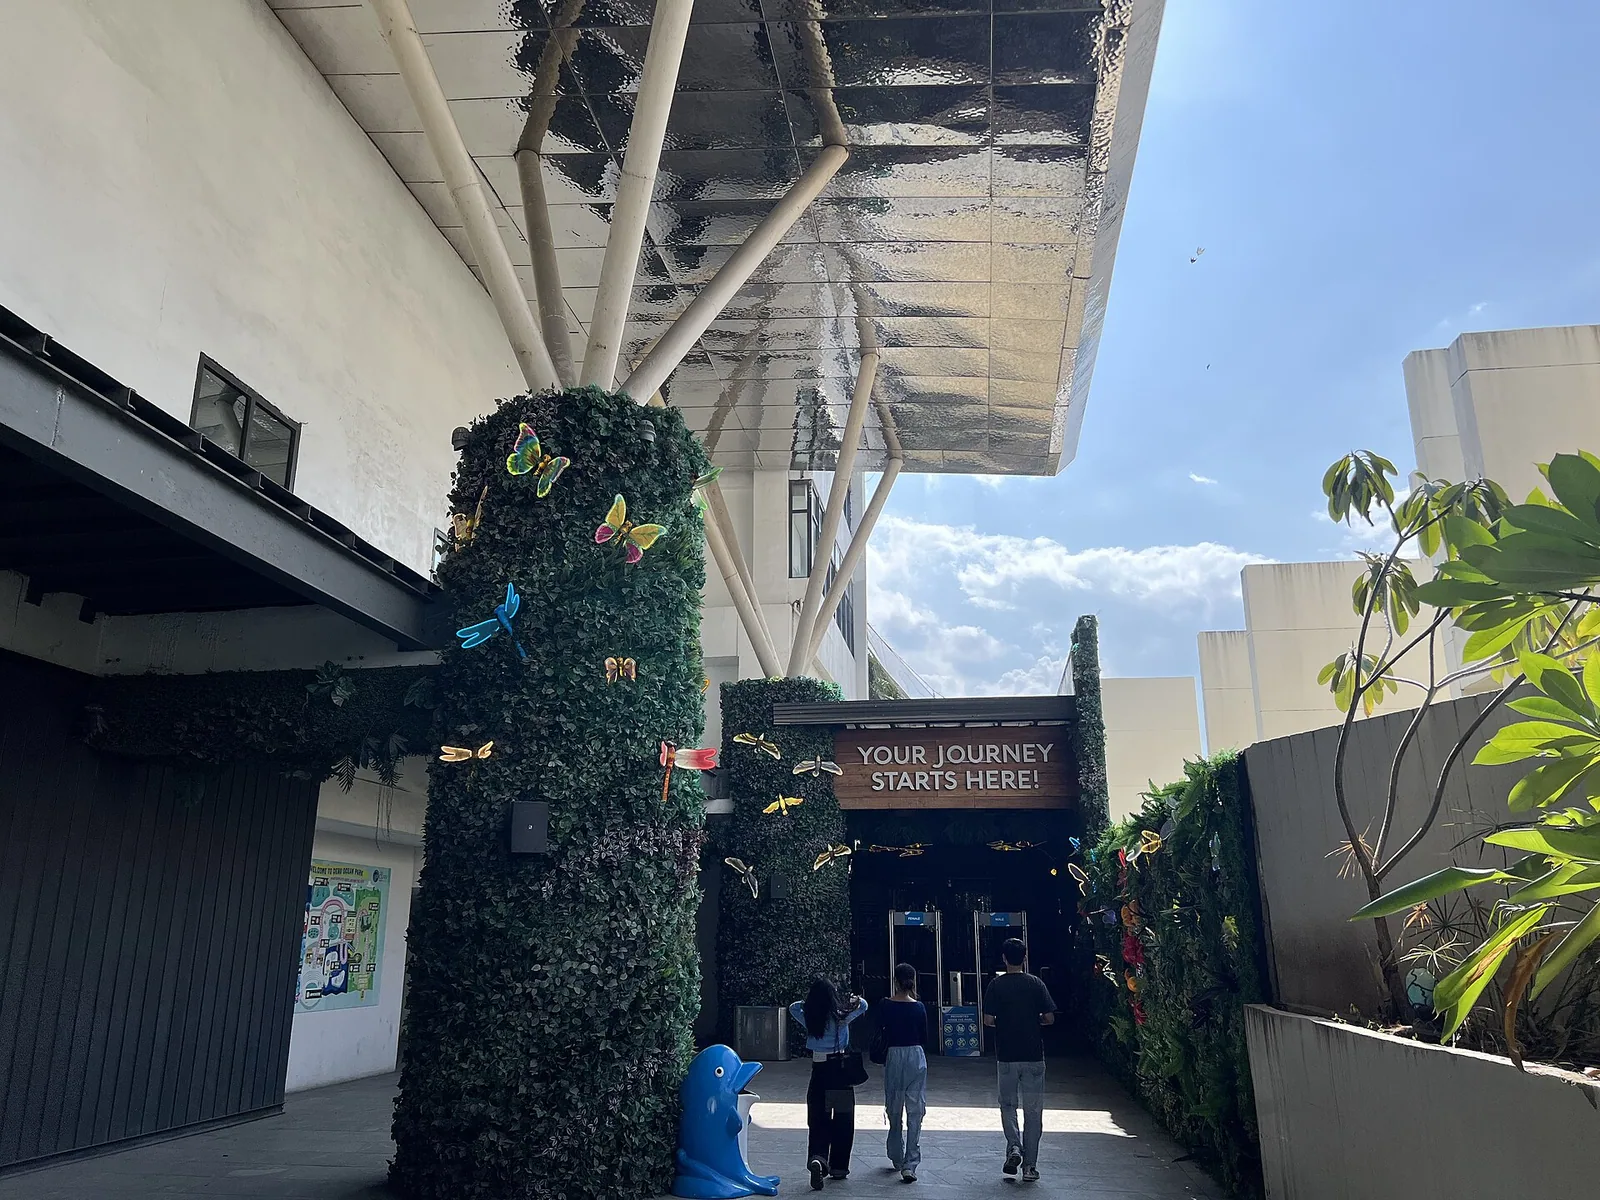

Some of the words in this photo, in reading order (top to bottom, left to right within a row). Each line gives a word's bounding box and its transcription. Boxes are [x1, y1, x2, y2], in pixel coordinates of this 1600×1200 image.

[857, 745, 927, 765] YOUR
[932, 743, 1054, 769] JOURNEY
[871, 770, 958, 791] STARTS
[966, 769, 1040, 790] HERE!
[311, 865, 327, 875] ELCOME
